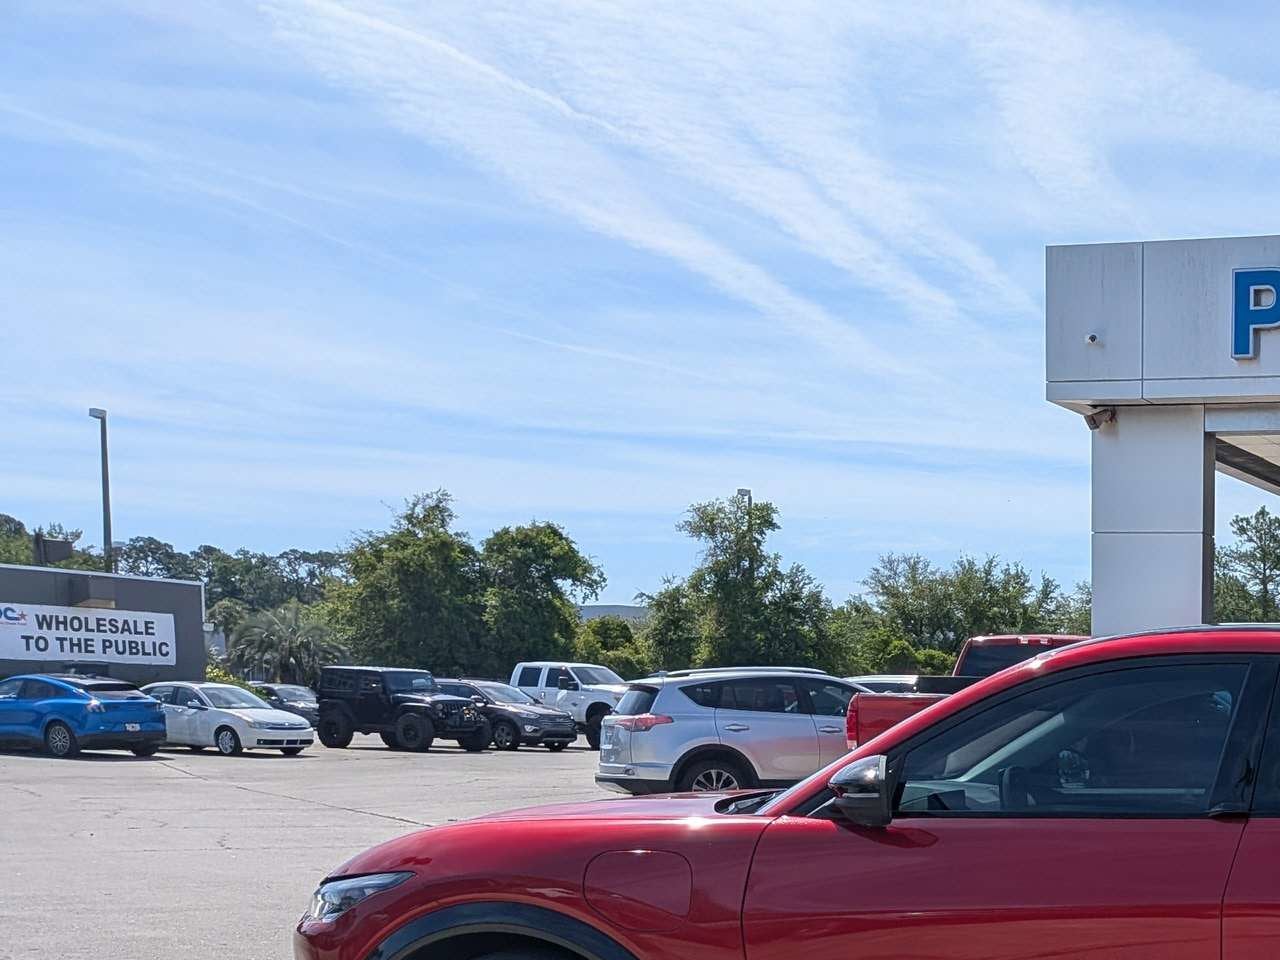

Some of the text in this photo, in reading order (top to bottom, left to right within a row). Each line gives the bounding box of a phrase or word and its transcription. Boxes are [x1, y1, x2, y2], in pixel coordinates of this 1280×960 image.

[35, 613, 155, 636] WHOLESALE
[21, 635, 170, 657] TO THE PUBLIC
